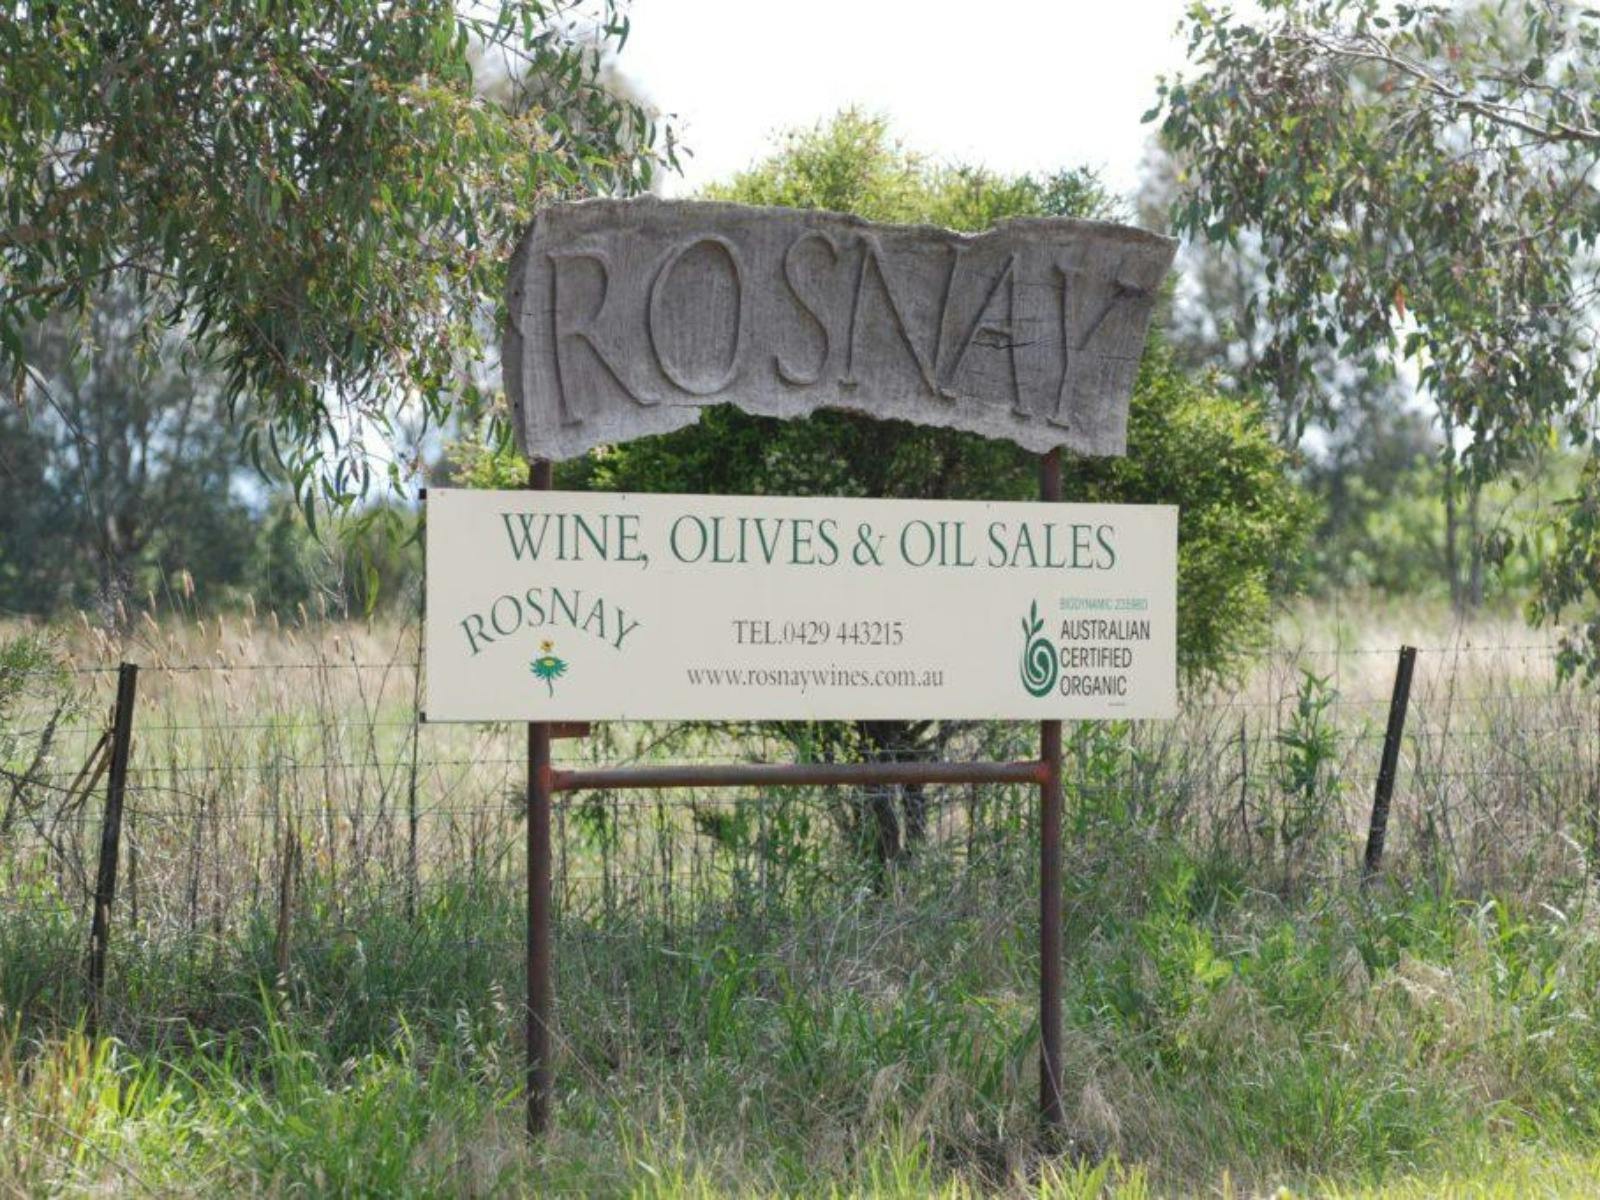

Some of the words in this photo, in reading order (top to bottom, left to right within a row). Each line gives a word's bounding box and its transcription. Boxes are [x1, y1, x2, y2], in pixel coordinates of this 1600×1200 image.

[546, 231, 1153, 430] ROSNAY
[501, 512, 649, 569] WINE,
[669, 515, 841, 567] OLIVES
[853, 522, 887, 567] &
[900, 519, 977, 567] OIL
[987, 521, 1116, 571] SALES
[459, 587, 641, 656] ROSNAY
[835, 620, 905, 647] 443215
[1060, 618, 1151, 641] AUSTRALIAN
[1060, 647, 1133, 669] CERTIFIED
[687, 663, 944, 696] www.rosnaywines.com.au
[1059, 675, 1128, 697] ORGANIC
